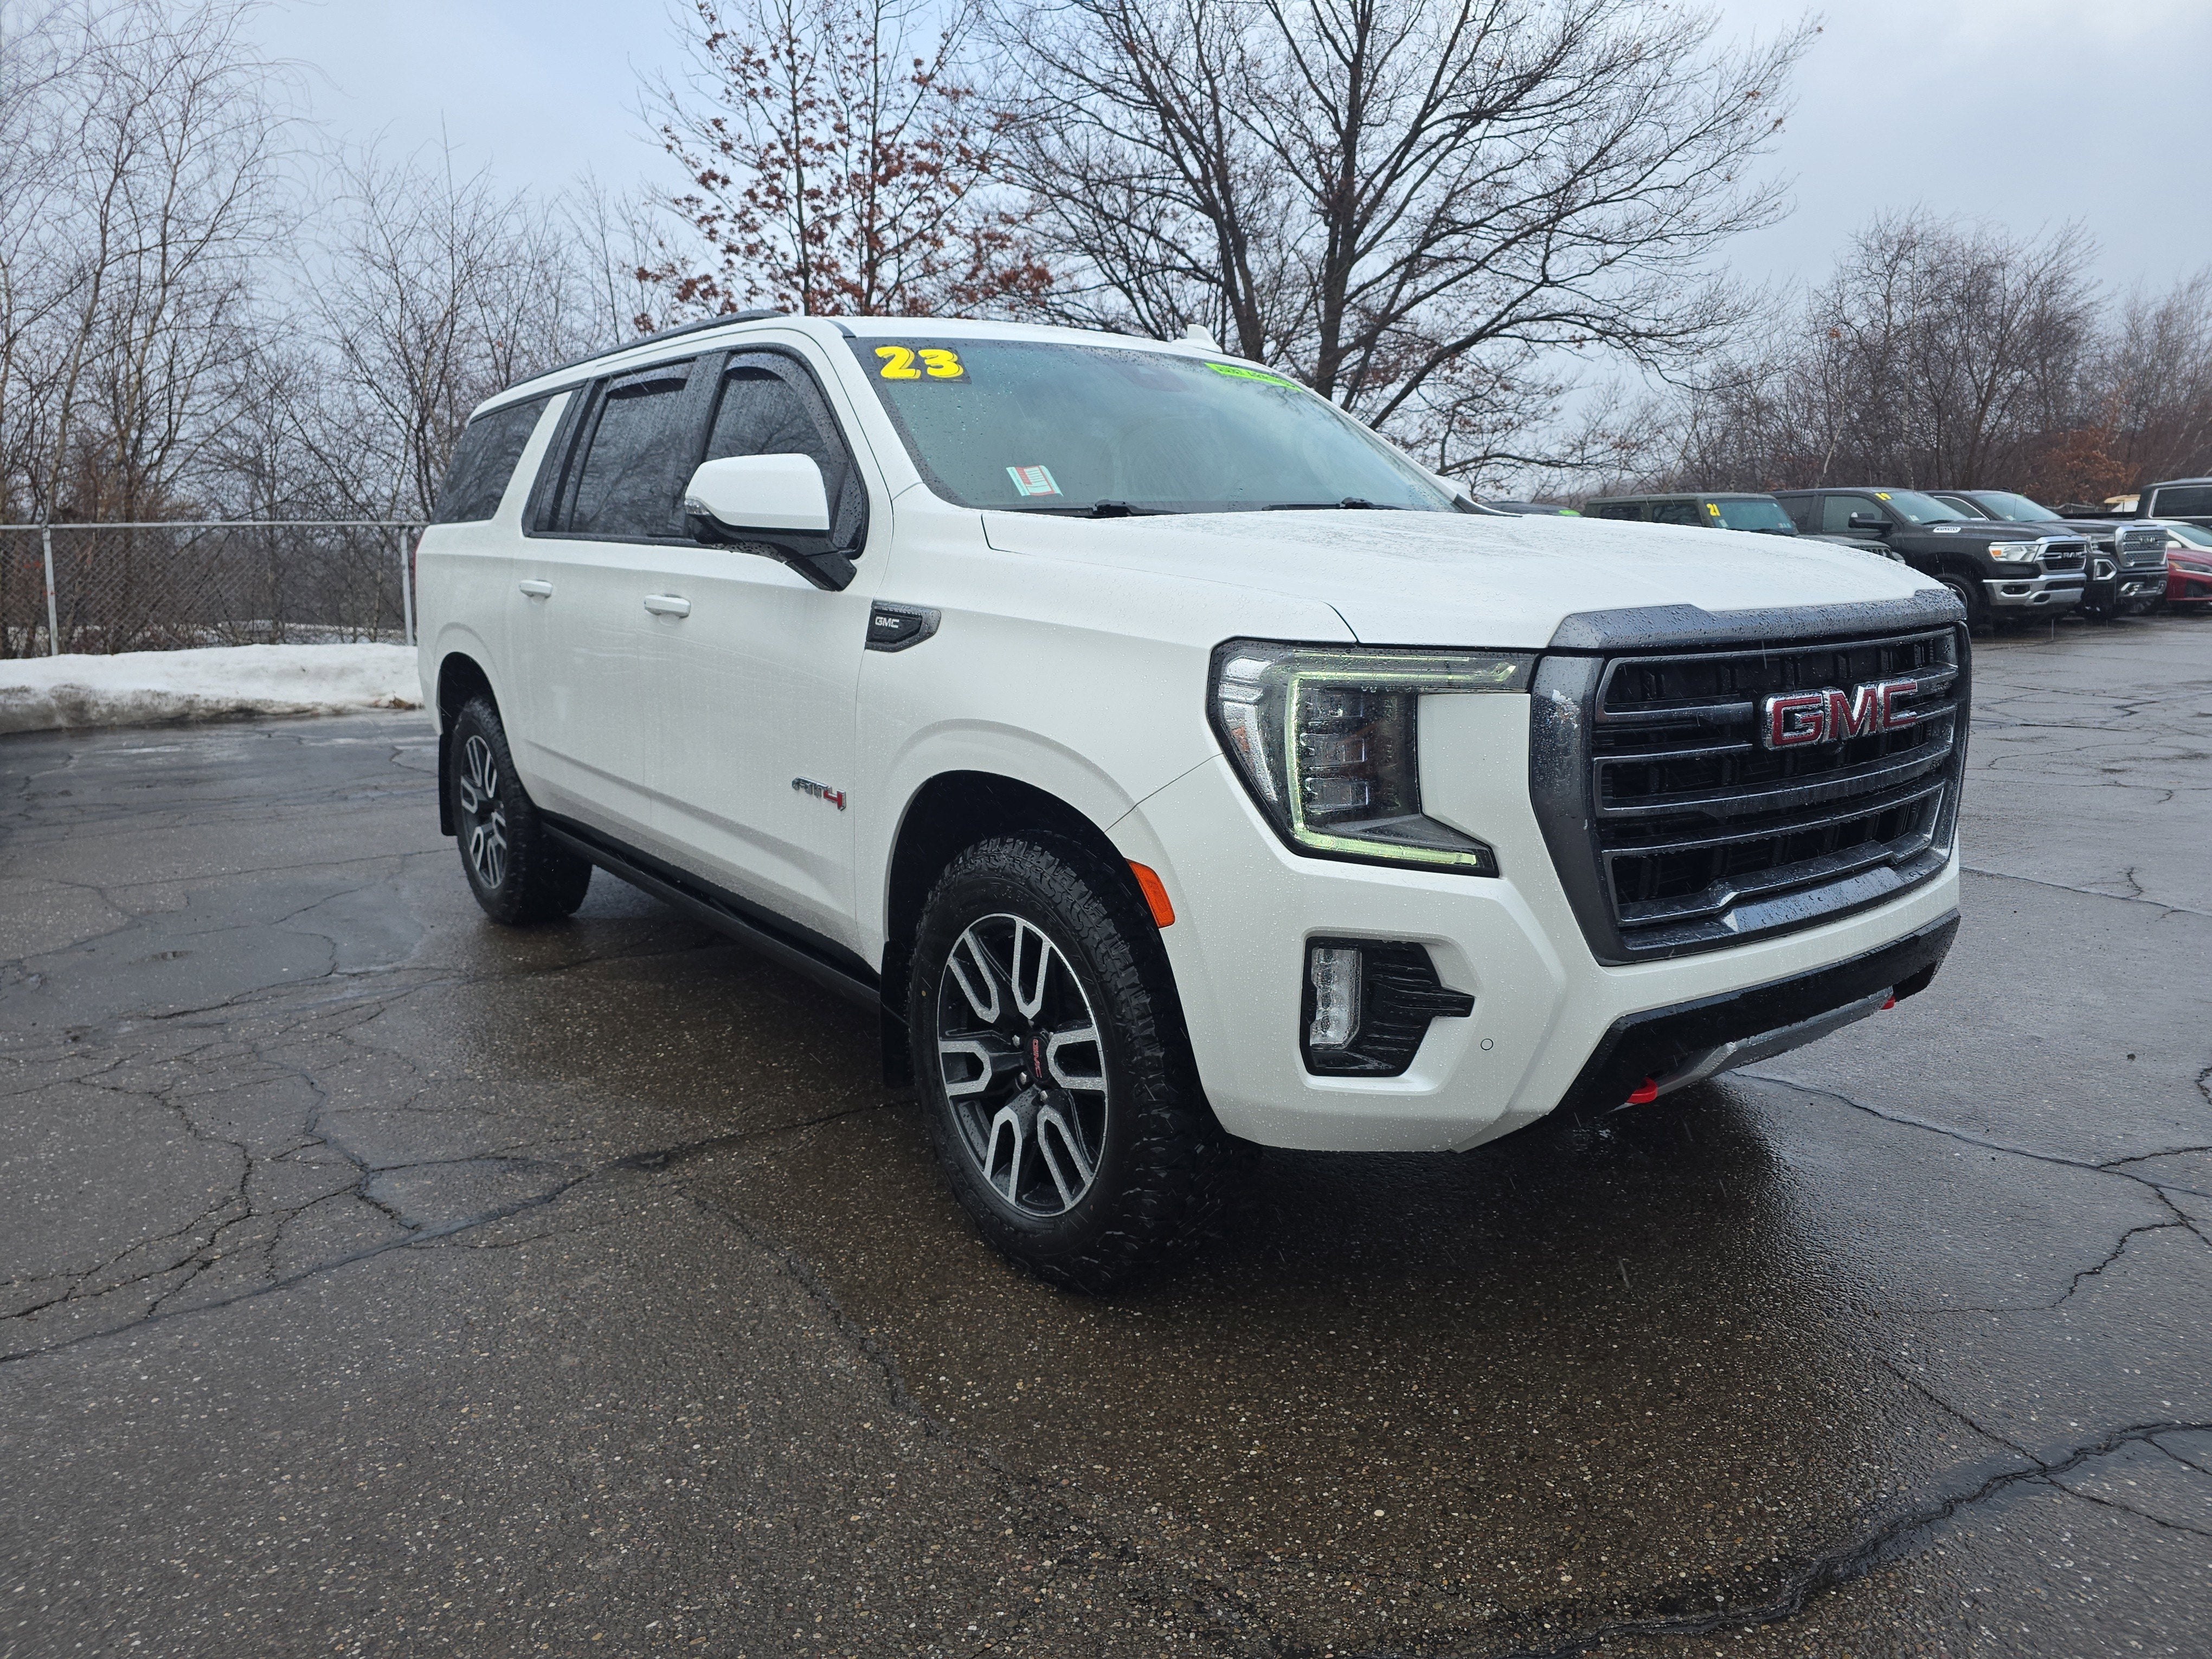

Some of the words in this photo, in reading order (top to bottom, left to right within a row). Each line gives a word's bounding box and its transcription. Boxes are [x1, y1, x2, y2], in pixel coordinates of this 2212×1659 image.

[875, 346, 964, 379] 23
[1707, 503, 1721, 516] 21
[875, 616, 899, 628] GMC
[1763, 678, 1918, 750] GMC
[792, 776, 846, 811] AT4
[1033, 1039, 1042, 1078] GMC
